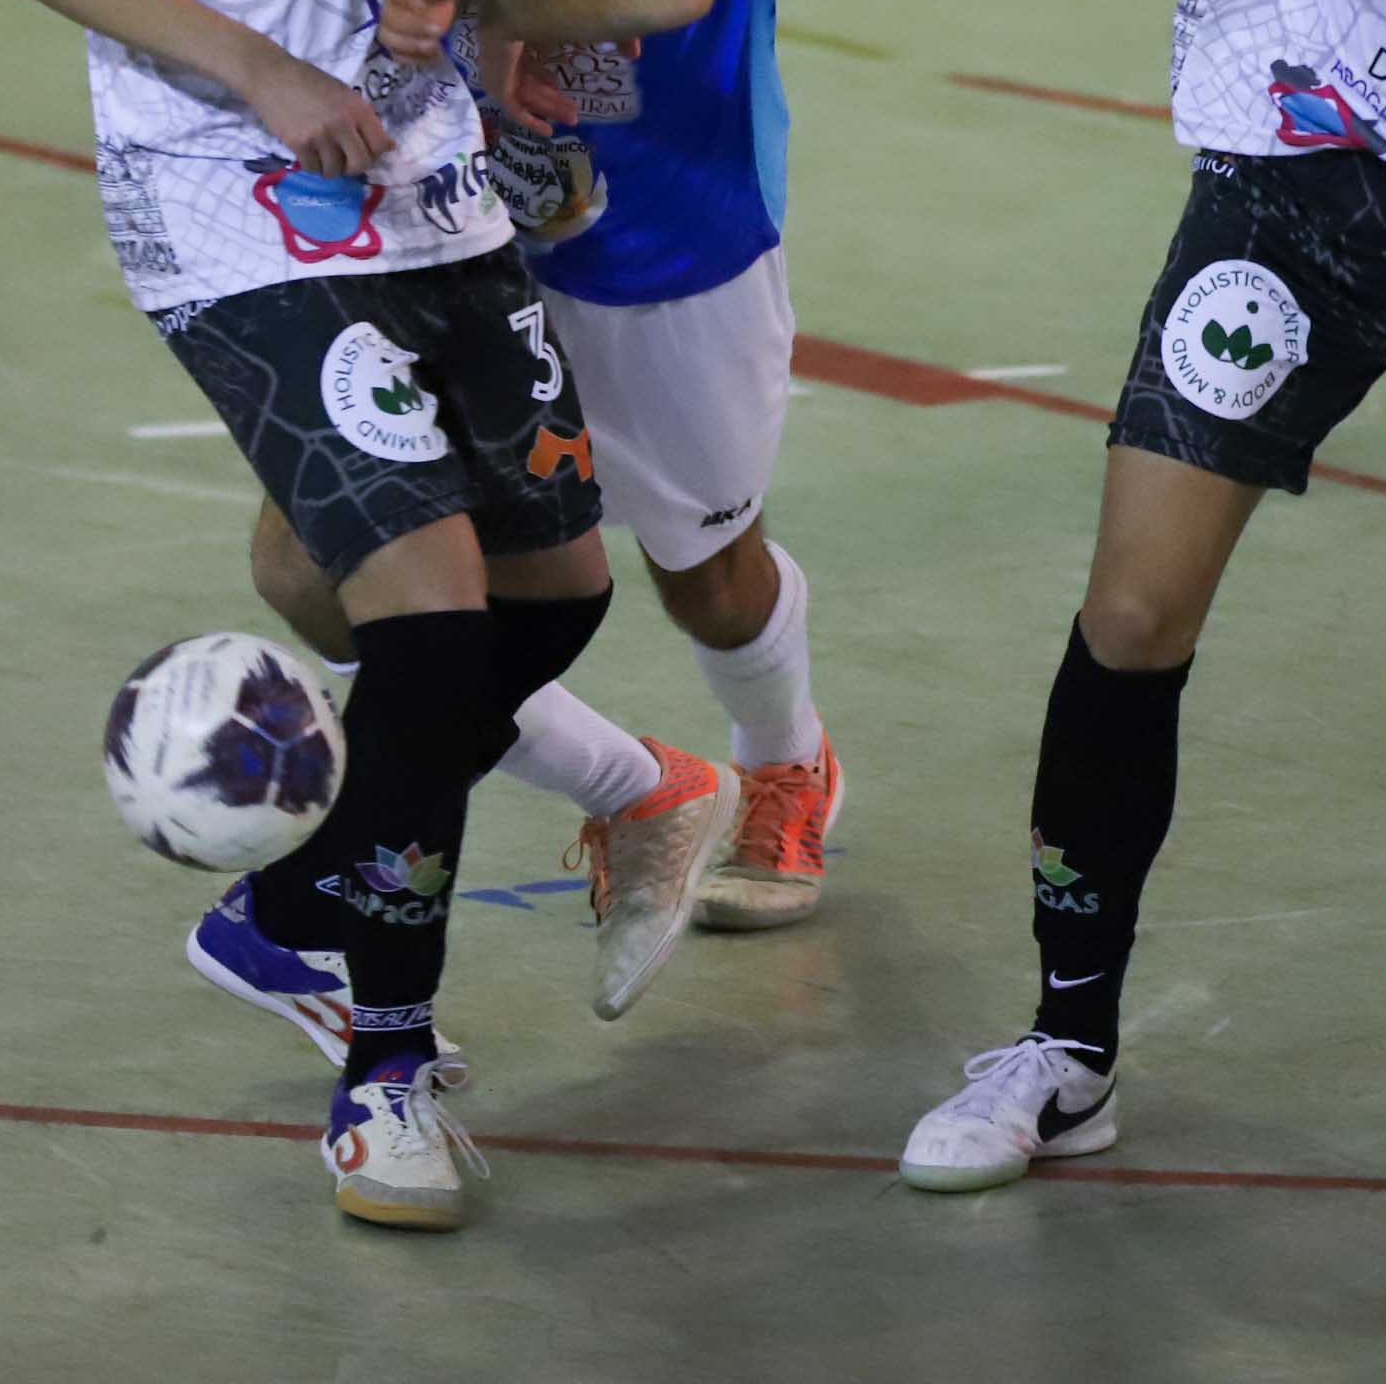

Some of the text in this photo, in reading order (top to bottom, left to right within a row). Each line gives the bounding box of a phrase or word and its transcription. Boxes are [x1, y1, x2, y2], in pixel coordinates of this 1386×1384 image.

[508, 301, 563, 402] 3
[1177, 270, 1300, 366] HOLISTIC CENTER
[1172, 338, 1276, 409] BODY & MIND
